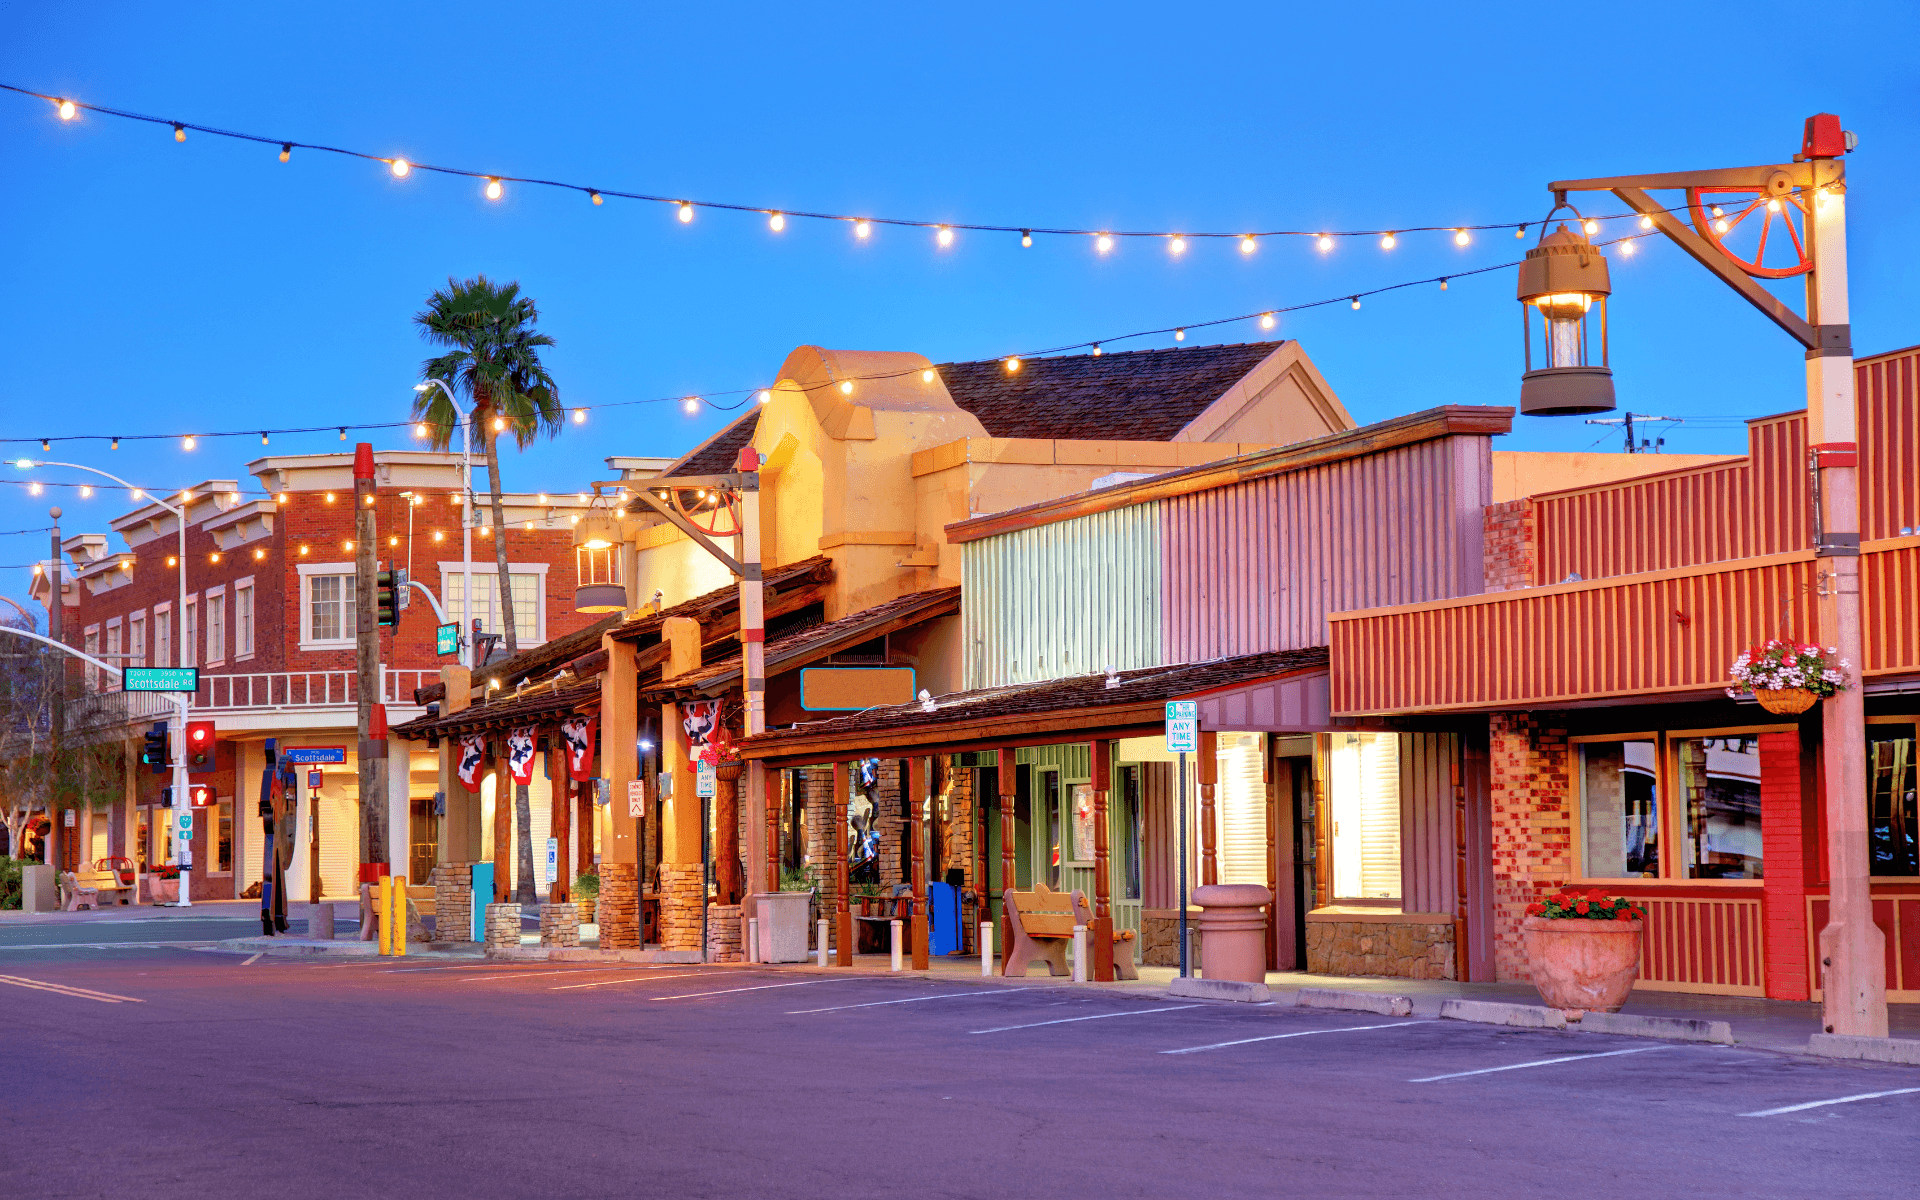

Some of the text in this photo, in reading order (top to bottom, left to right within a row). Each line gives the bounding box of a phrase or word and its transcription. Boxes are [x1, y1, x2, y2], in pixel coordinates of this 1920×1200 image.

[130, 678, 180, 689] Scottsdale
[1169, 706, 1174, 717] 3
[295, 754, 336, 762] Scottsdale
[698, 761, 703, 772] 3
